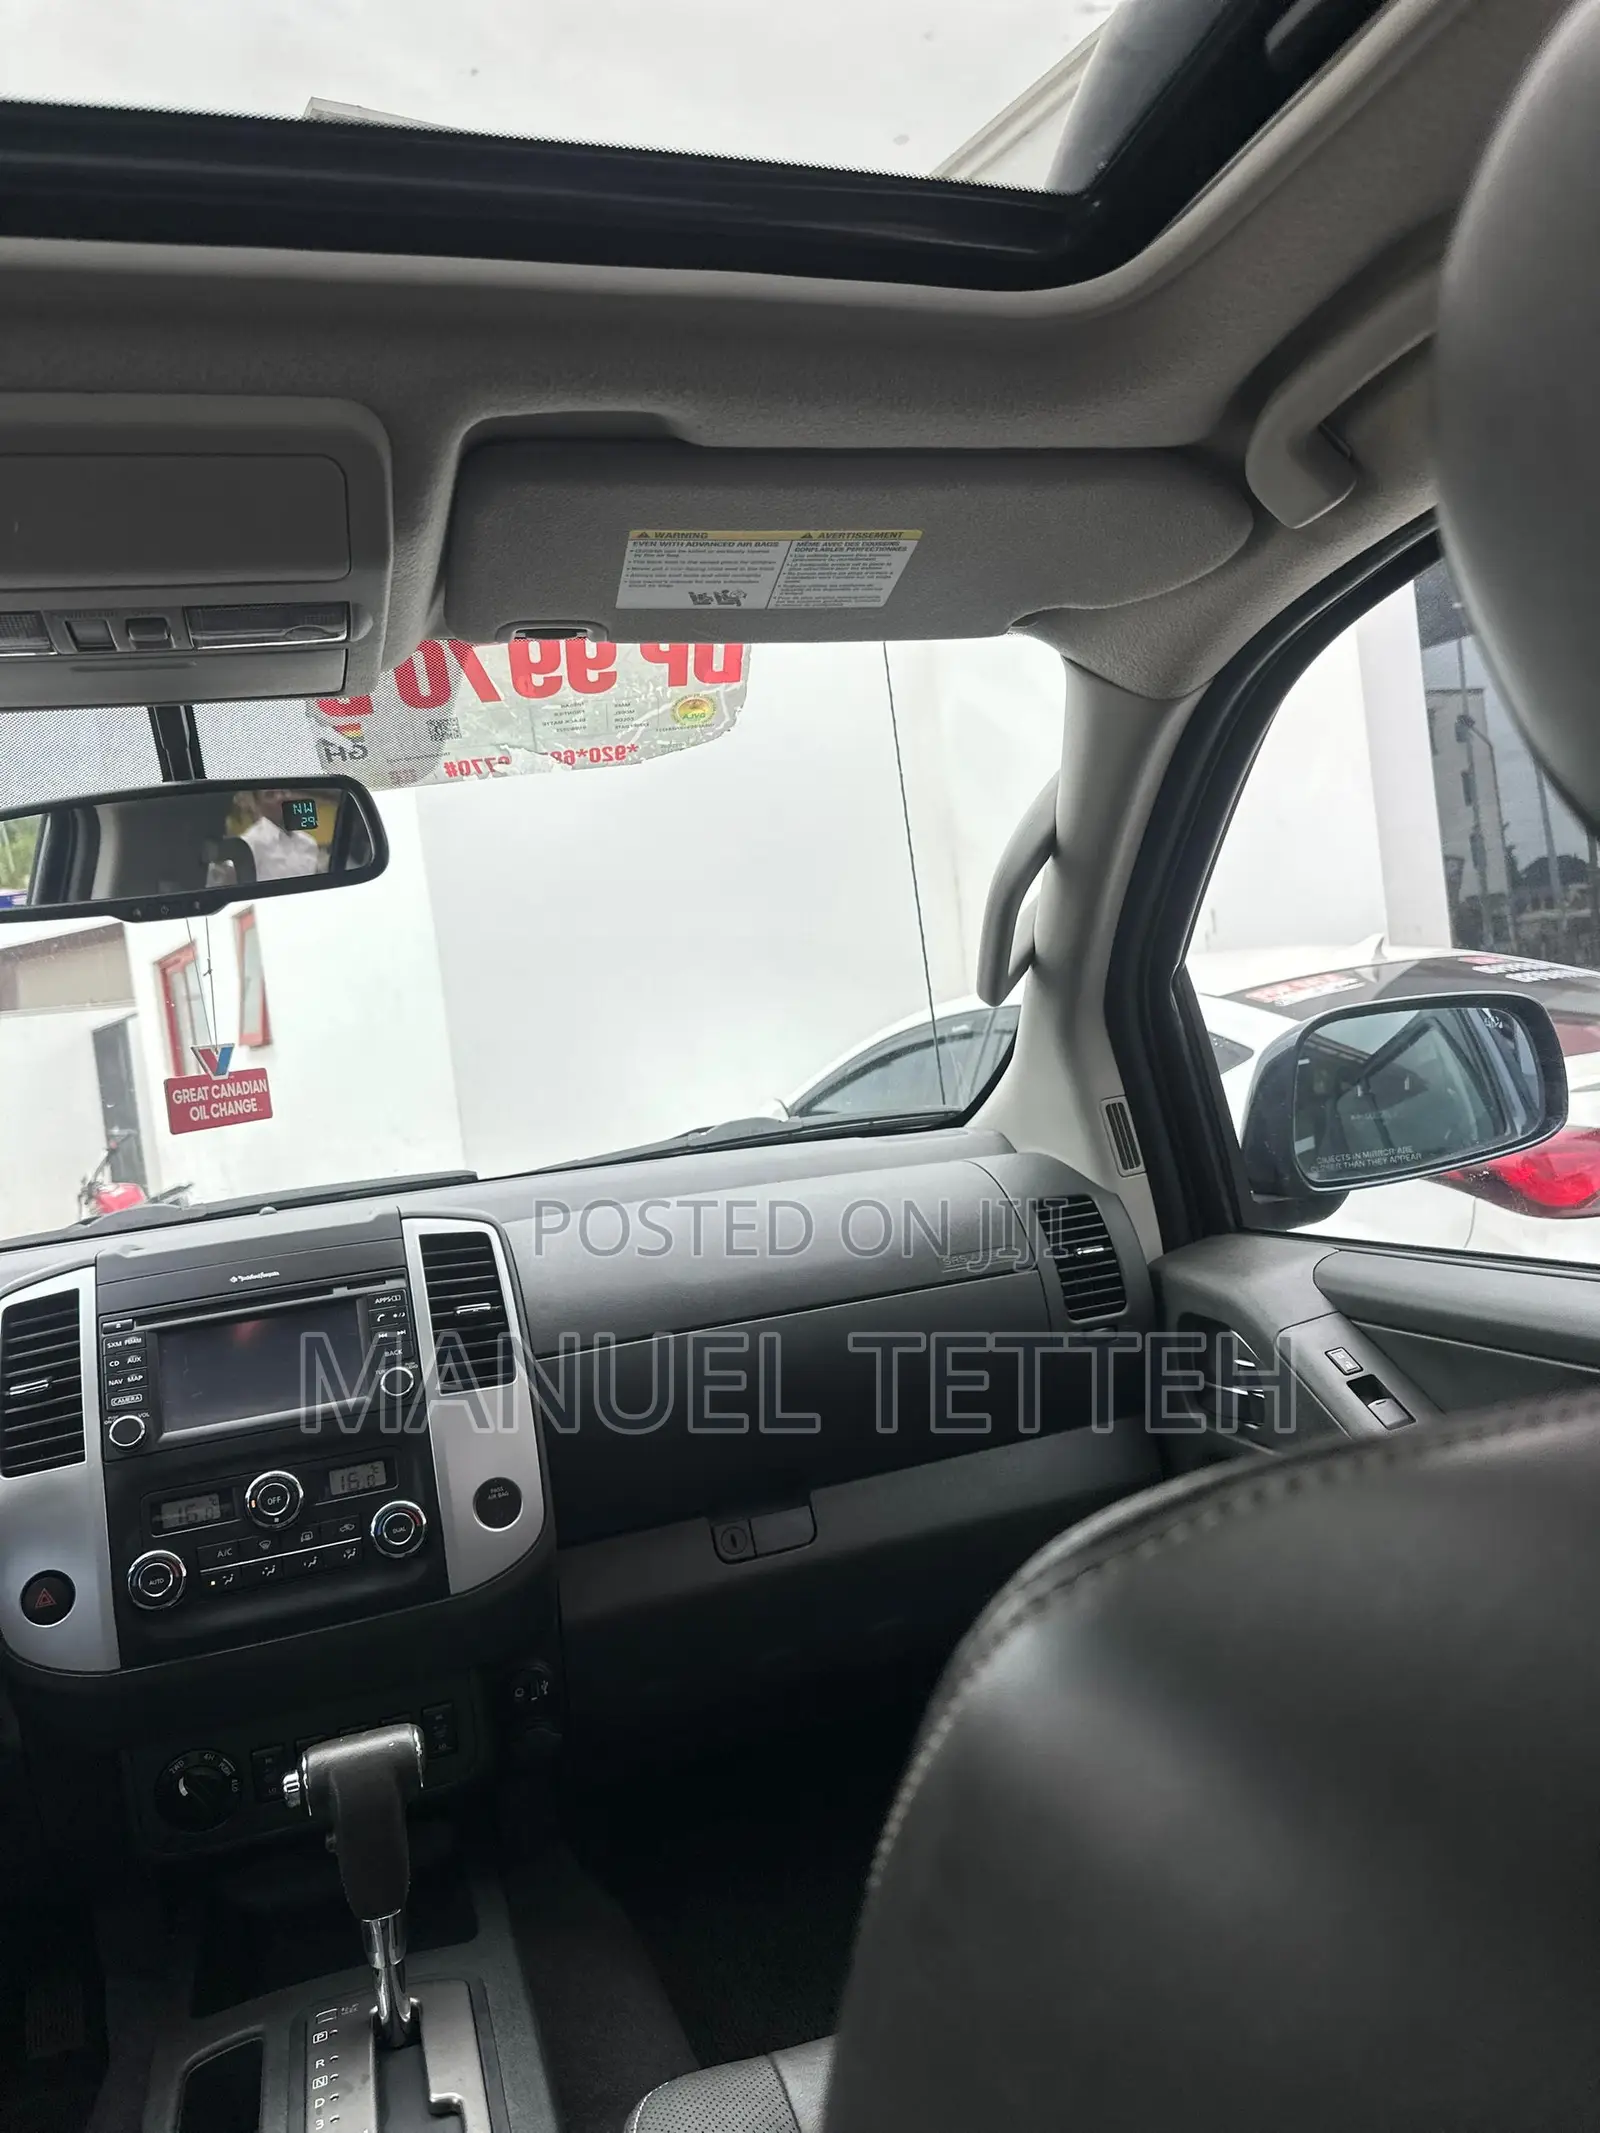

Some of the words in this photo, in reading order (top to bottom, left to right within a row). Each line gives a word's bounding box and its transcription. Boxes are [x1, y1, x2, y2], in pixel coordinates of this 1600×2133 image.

[292, 802, 313, 814] NW
[301, 816, 316, 828] 29
[172, 1086, 210, 1104] GREAT
[211, 1079, 268, 1099] CANADIAN
[190, 1105, 210, 1121] OIL
[210, 1098, 258, 1118] CHANGE
[1352, 1152, 1362, 1160] IN
[1362, 1148, 1395, 1158] MIRROR
[1397, 1146, 1414, 1154] ARE
[1344, 1160, 1366, 1168] THAN
[1366, 1156, 1388, 1166] THEY
[1390, 1152, 1422, 1164] APPEAR
[107, 1341, 122, 1349] SXM
[384, 1348, 402, 1357] BACK
[109, 1360, 120, 1368] CD
[127, 1356, 142, 1364] AUX
[108, 1378, 123, 1386] NAV
[128, 1374, 143, 1382] MAP
[112, 1395, 141, 1405] CAMERA
[267, 1496, 282, 1506] OFF
[392, 1526, 407, 1534] DUAL
[217, 1548, 233, 1558] A/C
[148, 1578, 164, 1586] AUTO
[168, 1759, 186, 1774] 2WD
[314, 2032, 326, 2043] P
[315, 2058, 326, 2069] R
[314, 2077, 326, 2088] N
[314, 2098, 326, 2109] D
[315, 2119, 324, 2131] 3
